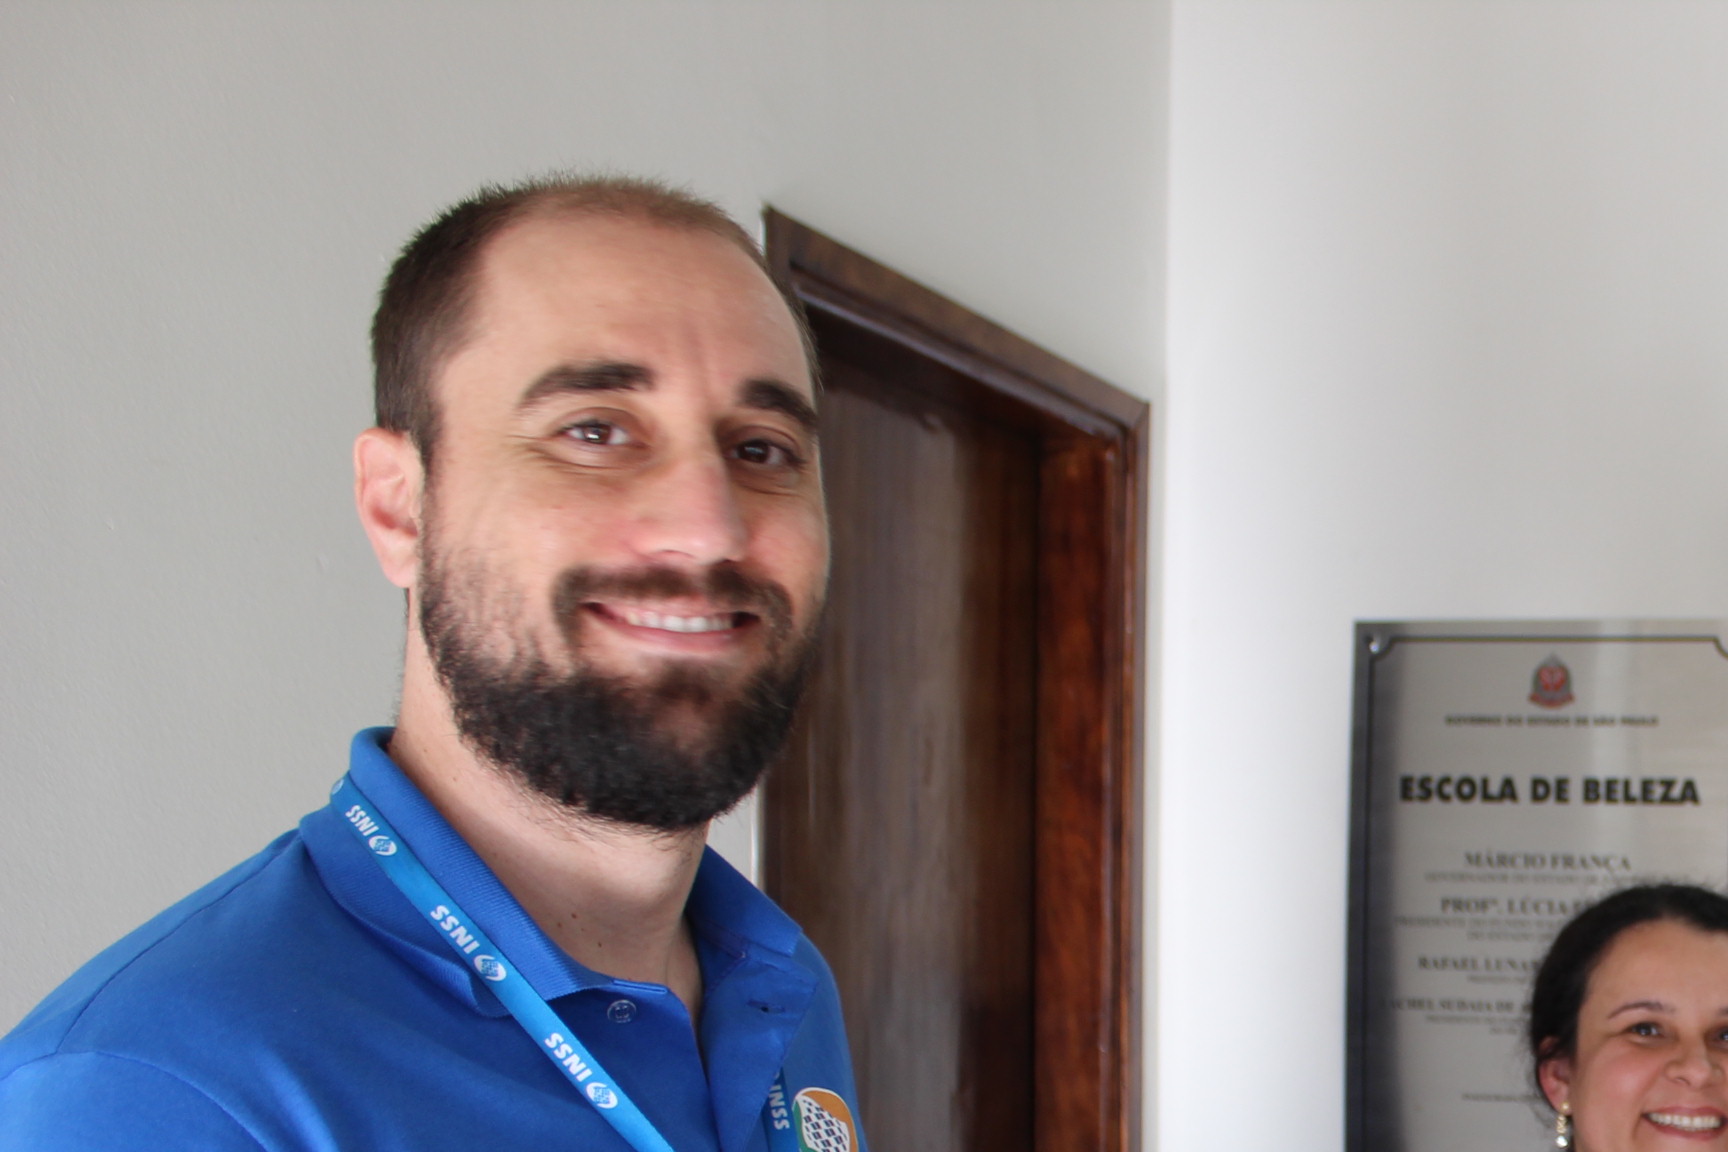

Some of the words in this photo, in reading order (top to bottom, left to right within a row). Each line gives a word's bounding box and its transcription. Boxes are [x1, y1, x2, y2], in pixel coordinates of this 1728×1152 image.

[1400, 775, 1518, 803] ESCOLA
[1530, 777, 1570, 804] DE
[1583, 778, 1699, 805] BELEZA
[345, 805, 379, 836] INSS
[430, 905, 480, 954] INSS
[545, 1032, 592, 1082] INSS
[769, 1084, 790, 1130] INSS
